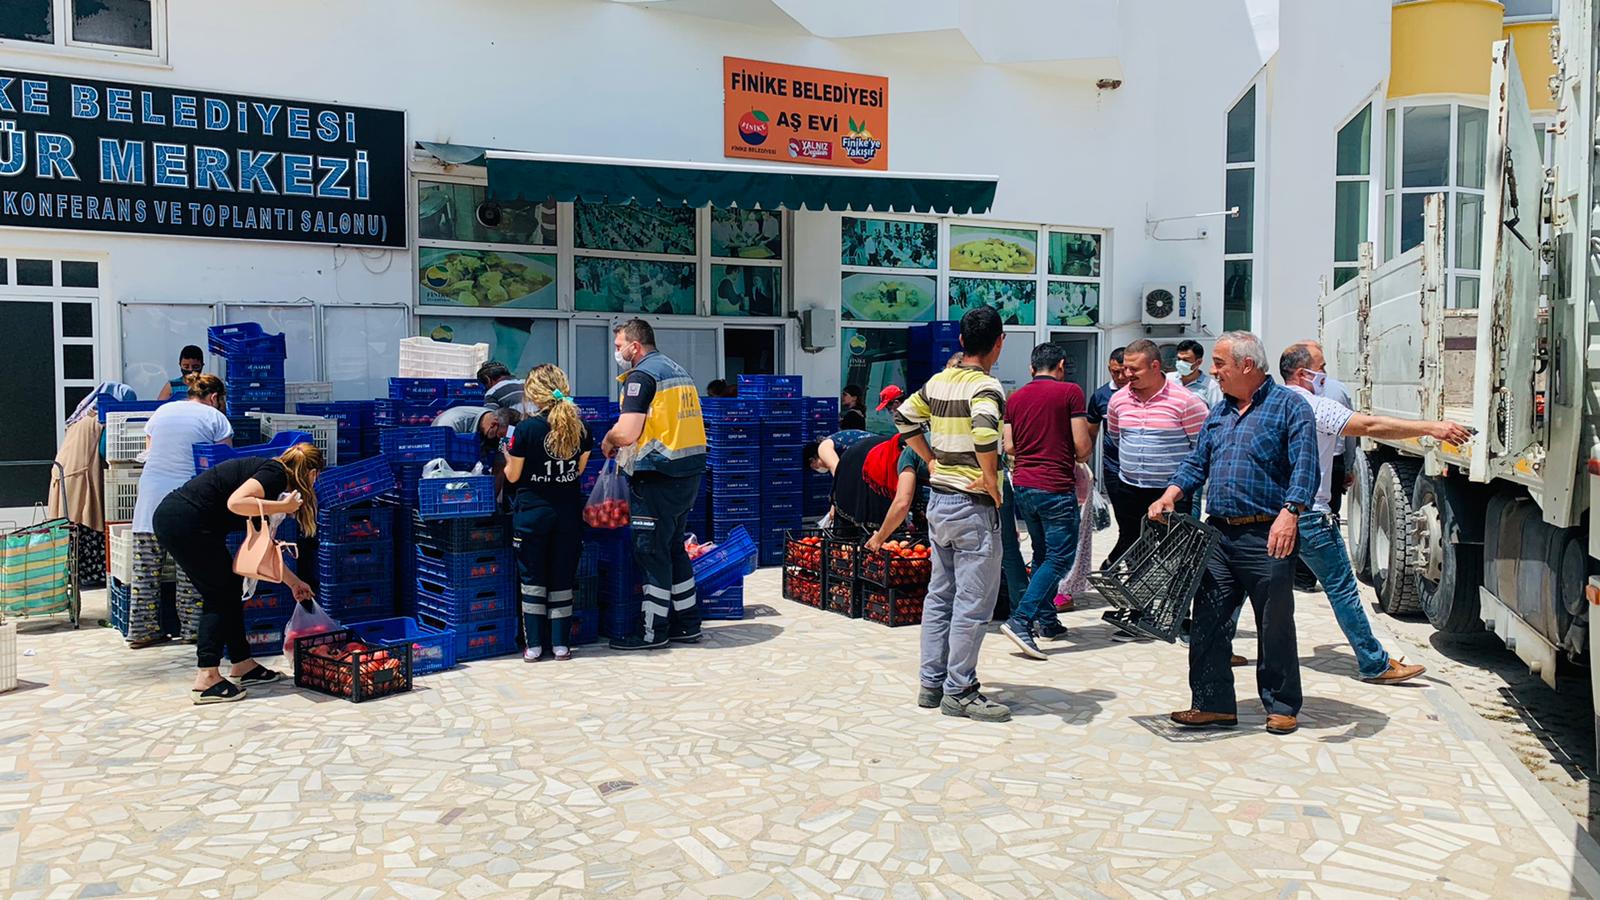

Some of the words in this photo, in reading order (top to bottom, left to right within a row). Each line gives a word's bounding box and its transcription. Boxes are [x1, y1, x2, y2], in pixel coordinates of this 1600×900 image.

[731, 69, 787, 96] FİNİKE
[792, 81, 883, 108] BELEDİYESİ
[776, 111, 801, 133] AŞ
[808, 113, 838, 133] EVİ
[98, 135, 370, 201] MERKEZİ
[154, 199, 182, 225] VE
[188, 202, 293, 231] TOPLANTI
[544, 460, 577, 476] 112
